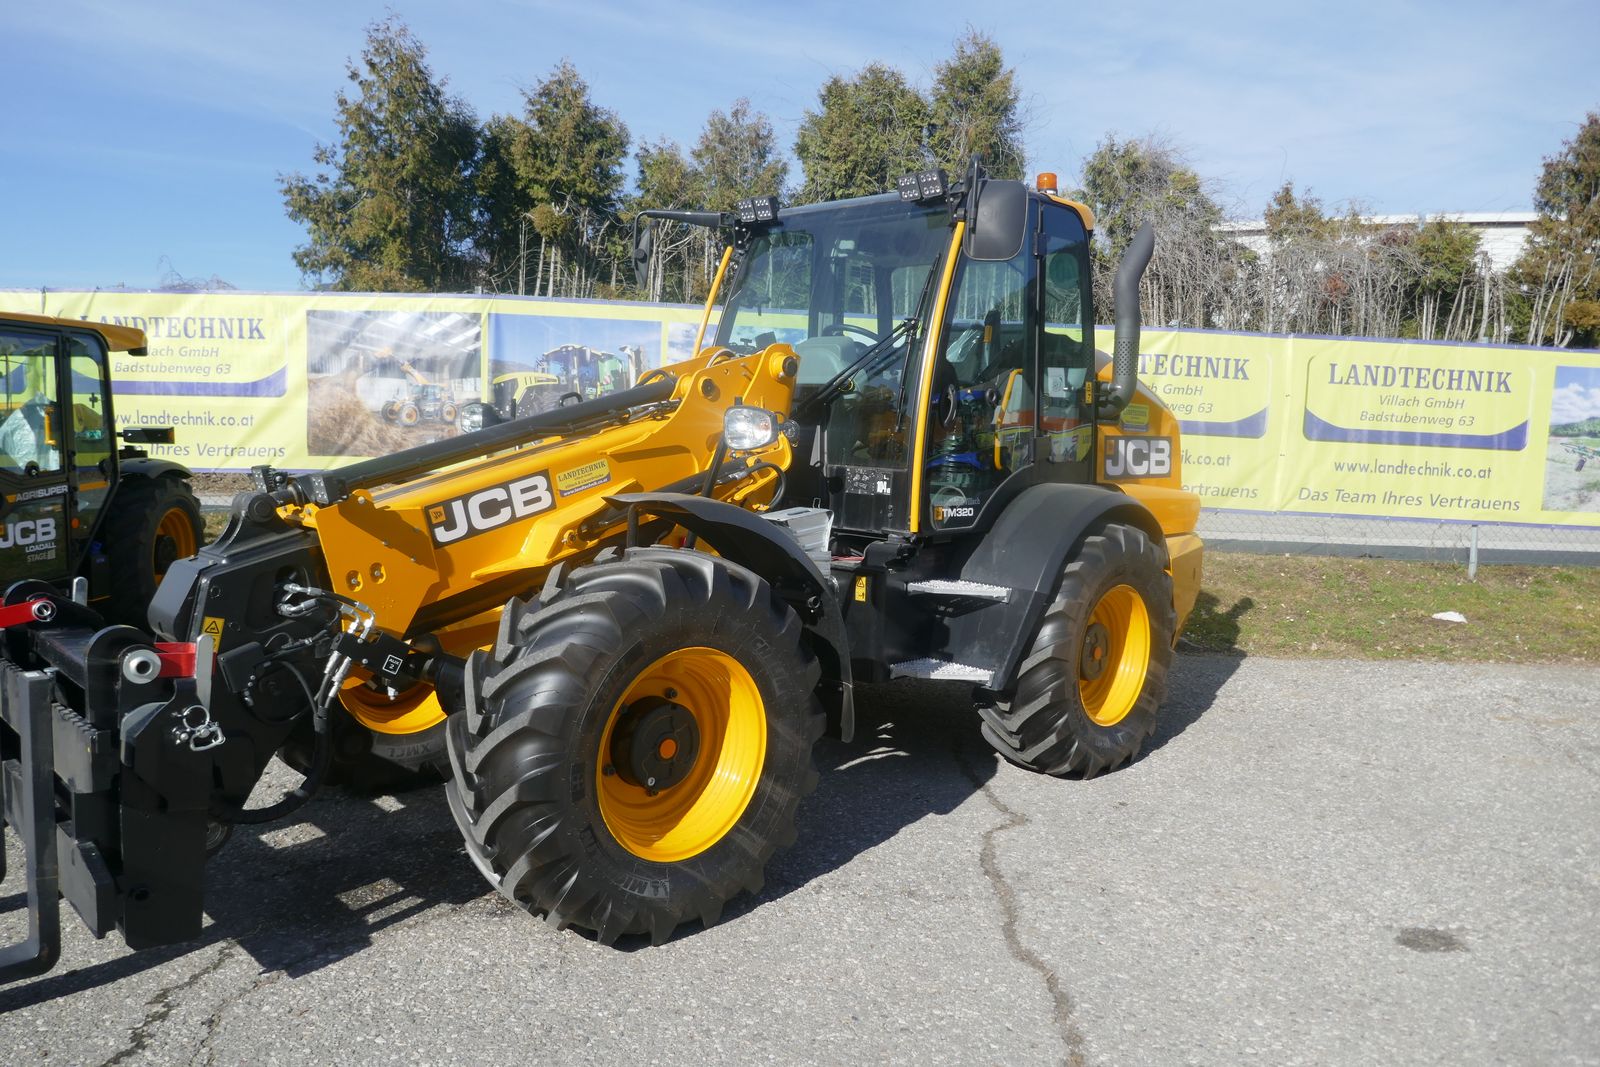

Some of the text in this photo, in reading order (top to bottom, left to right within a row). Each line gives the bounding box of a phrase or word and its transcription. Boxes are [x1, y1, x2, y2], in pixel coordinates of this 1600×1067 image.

[178, 346, 220, 358] GmbH
[114, 362, 231, 376] Badstubenweg 63
[1328, 363, 1512, 393] LANDTECHNIK
[1163, 383, 1204, 396] GmbH
[1197, 402, 1213, 414] 63
[1379, 395, 1465, 409] Villach GmbH
[1359, 411, 1475, 428] Badstubenweg 63
[150, 443, 190, 456] Ihres
[196, 443, 286, 457] Vertrauens
[1106, 439, 1171, 476] JCB
[558, 461, 606, 482] LANDTECHNIK
[1334, 459, 1492, 479] www.landtechnik.co.at
[1181, 483, 1259, 499] ertrauens
[1298, 487, 1520, 511] Das Team Ihres Vertrauens
[434, 475, 552, 543] JCB
[943, 507, 974, 517] TM320
[0, 517, 56, 548] JCB
